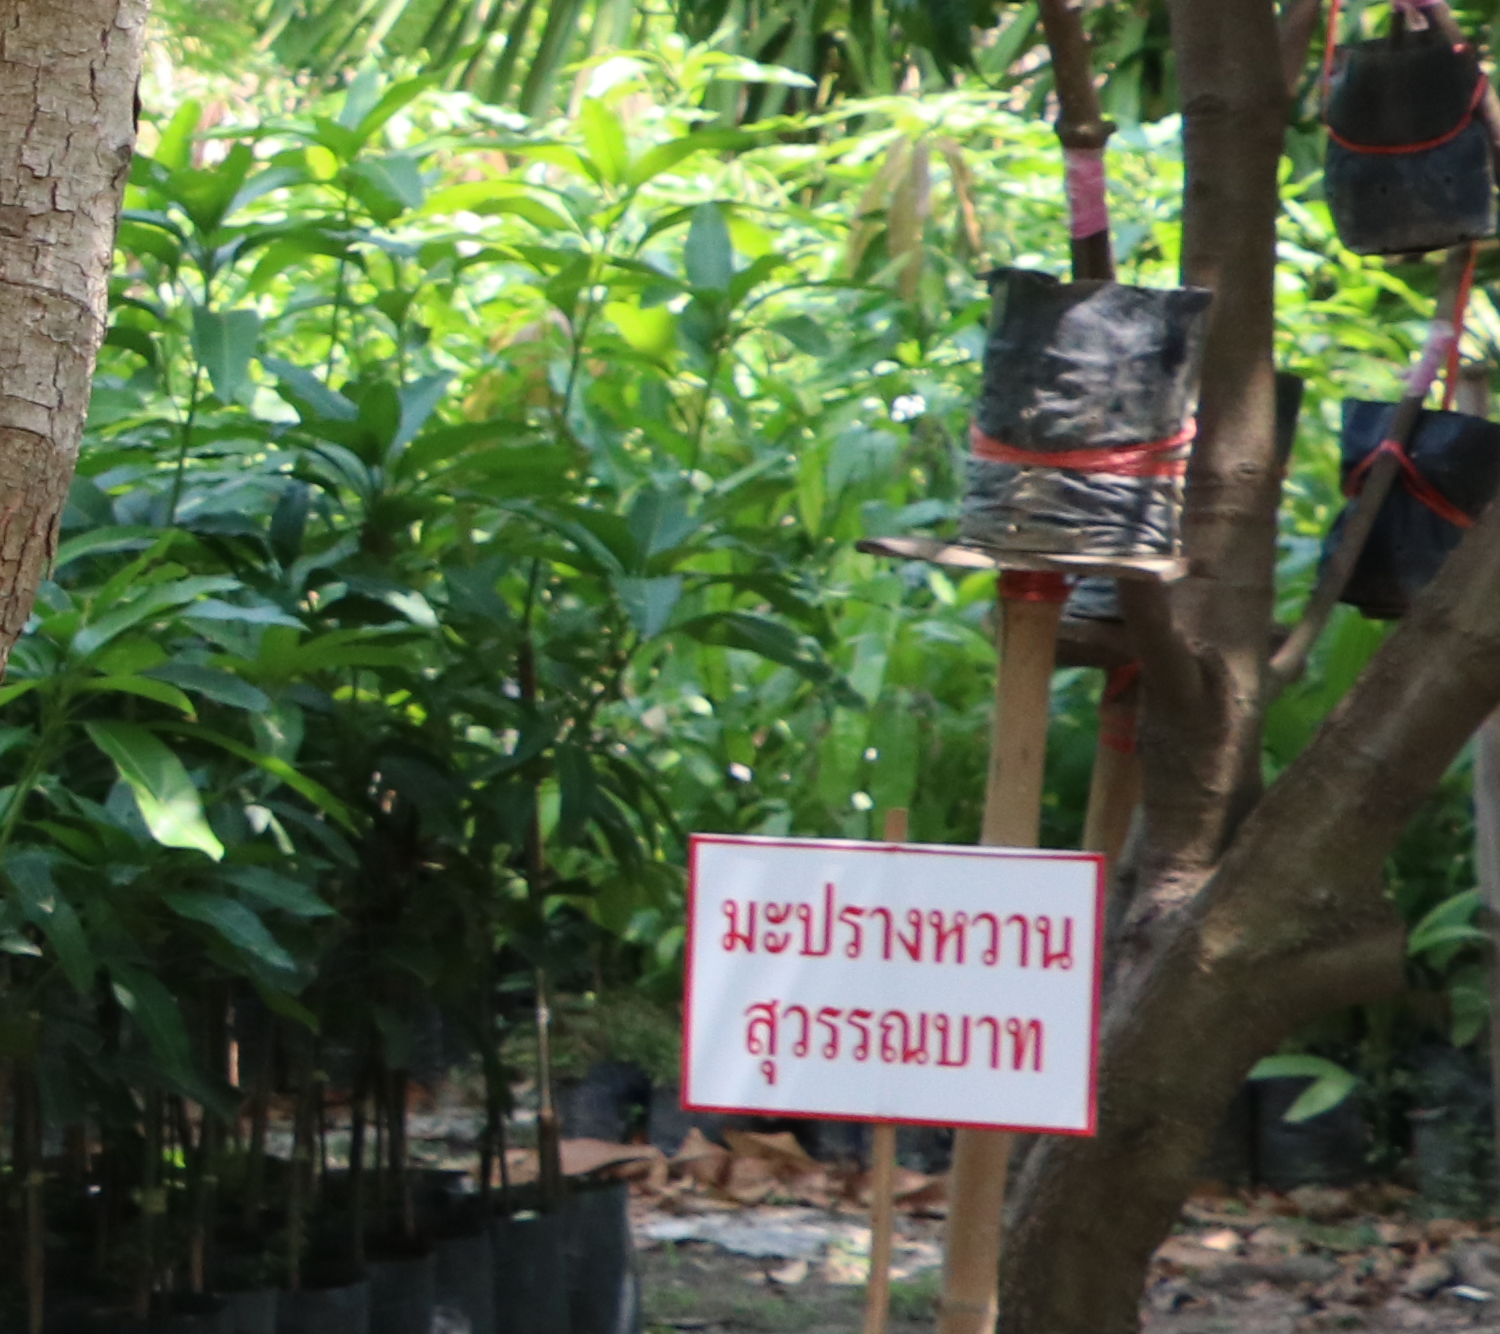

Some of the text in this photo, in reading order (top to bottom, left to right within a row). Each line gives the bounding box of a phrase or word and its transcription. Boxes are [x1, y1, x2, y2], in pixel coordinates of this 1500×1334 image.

[721, 882, 1075, 971] มะปรางหวาน
[744, 998, 1046, 1086] สุวรรณบาท
